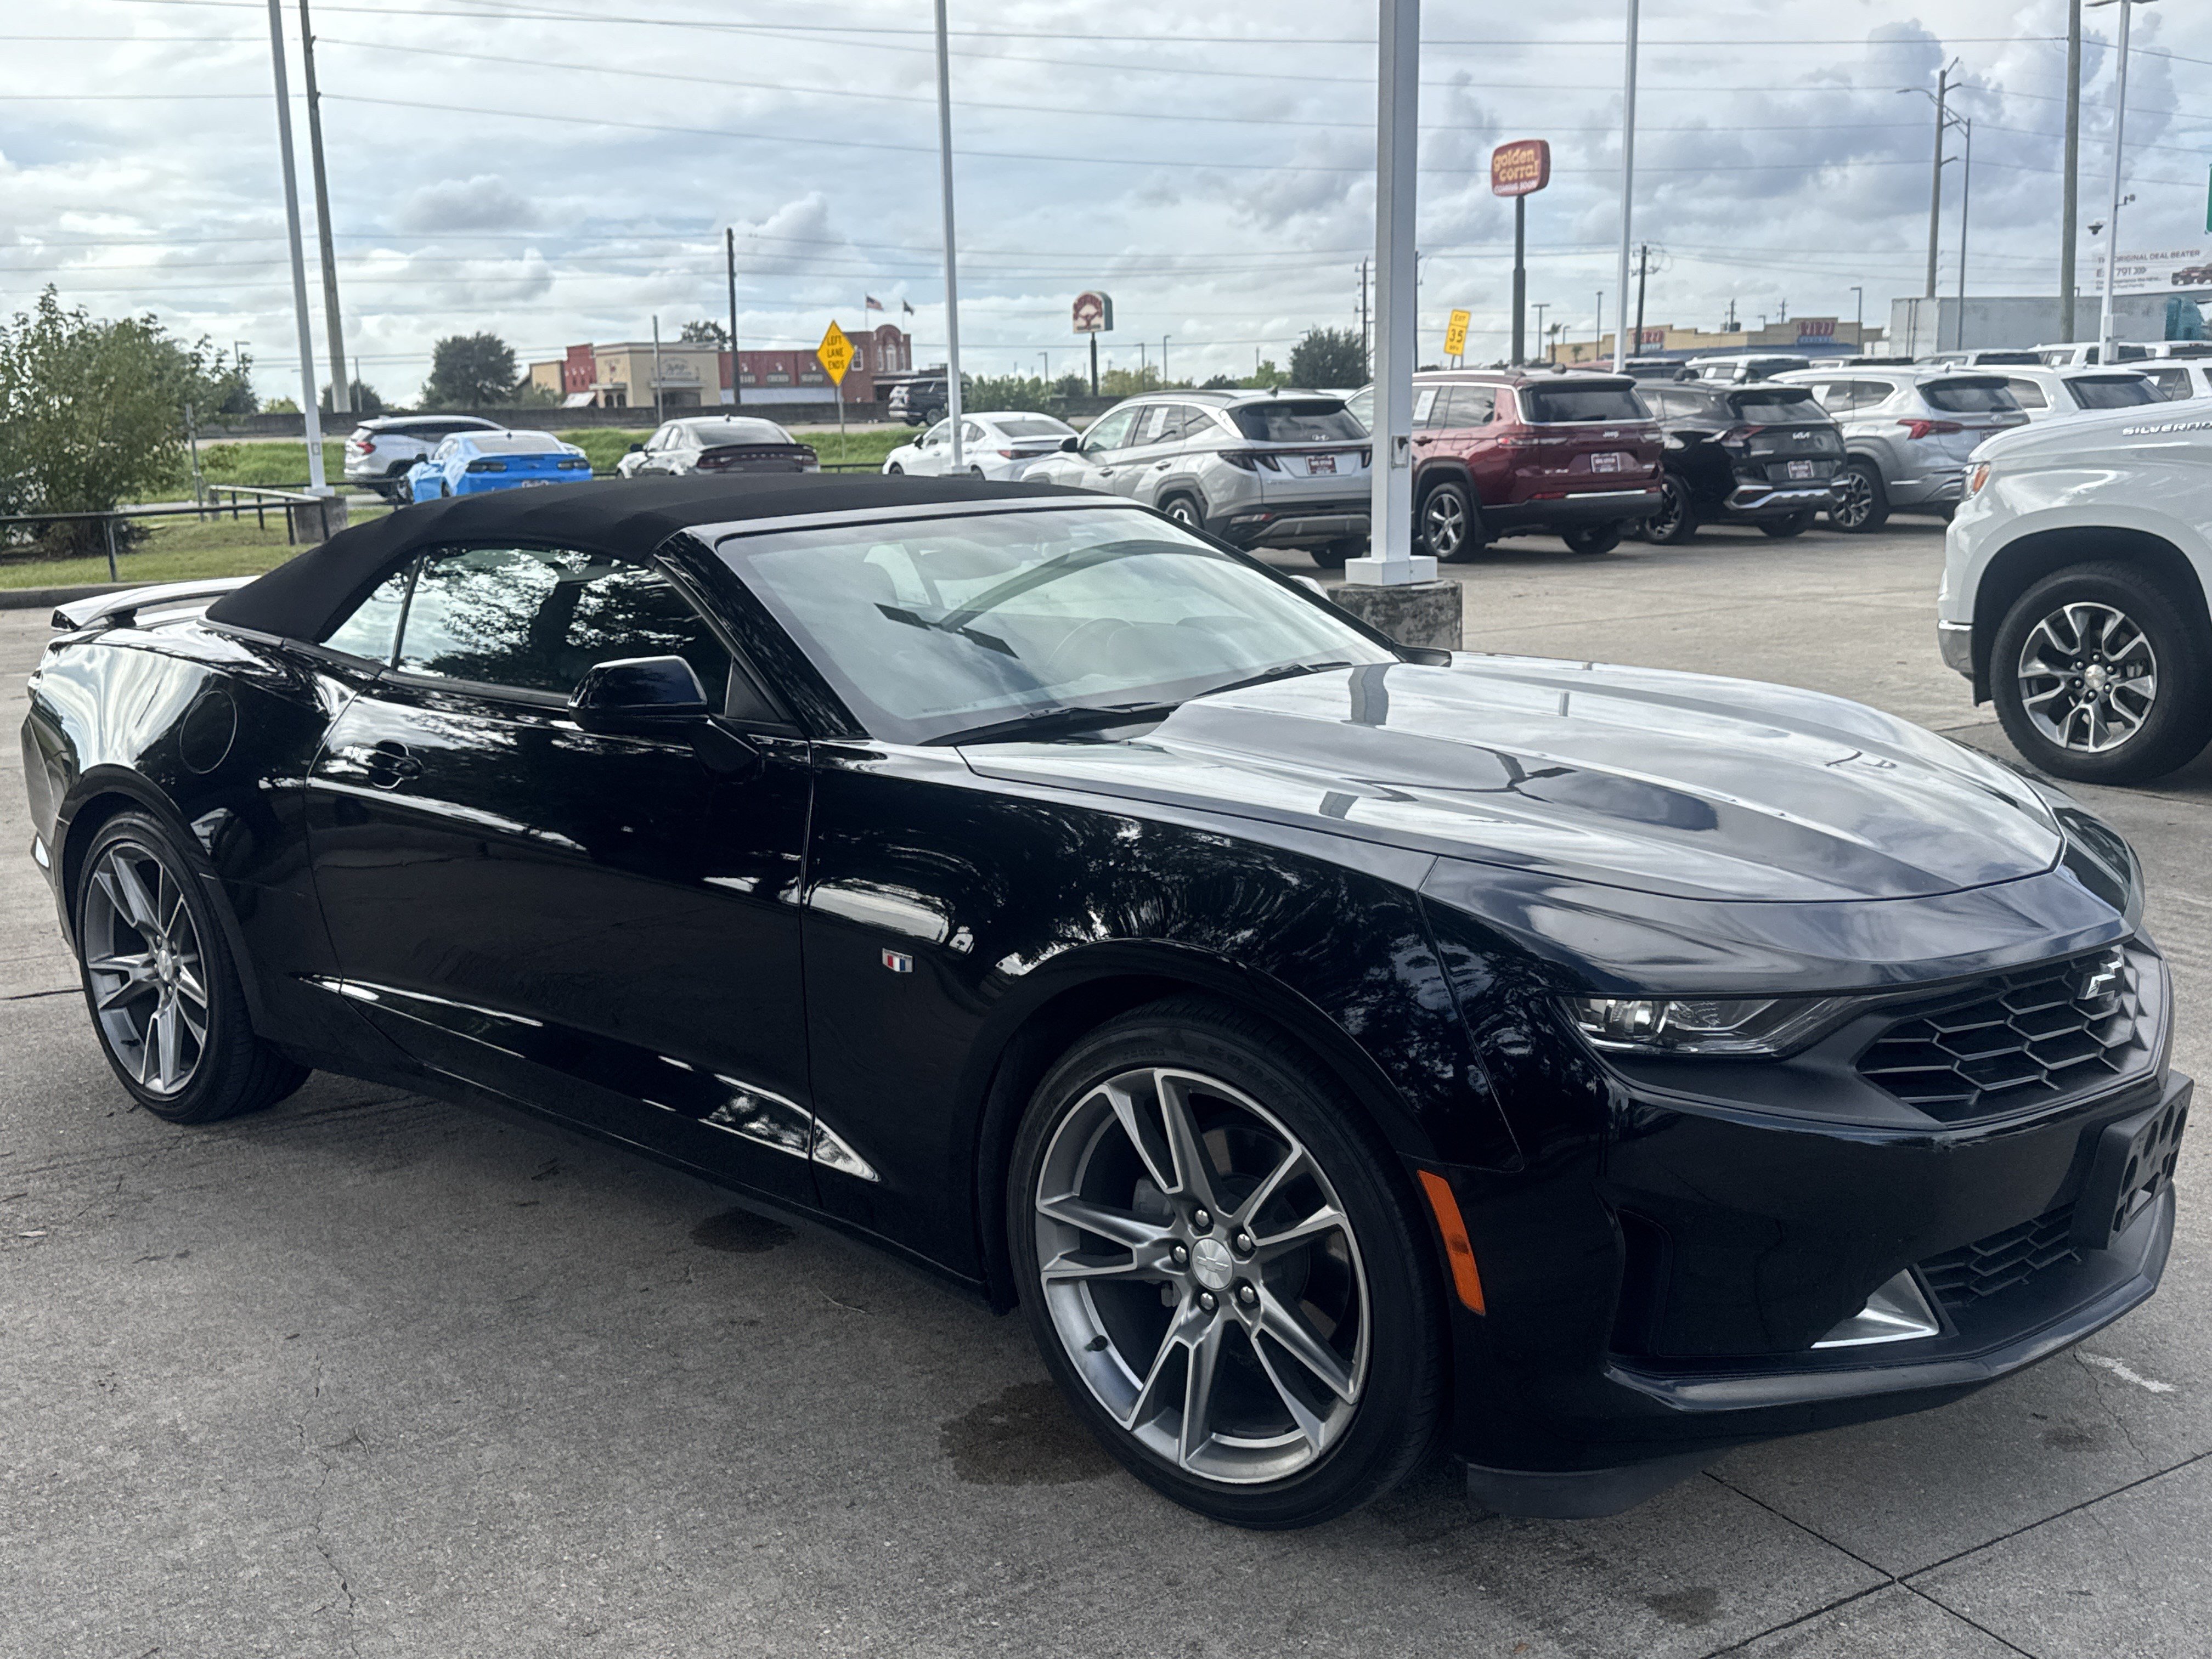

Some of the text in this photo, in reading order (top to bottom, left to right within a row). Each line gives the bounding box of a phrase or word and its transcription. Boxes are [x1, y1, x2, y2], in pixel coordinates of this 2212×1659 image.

[1494, 148, 1535, 172] golden
[1499, 160, 1538, 182] corral
[2149, 251, 2169, 260] DEAL
[2170, 249, 2200, 258] BEATER
[827, 335, 842, 346] LEFT
[1449, 328, 1464, 343] 35
[826, 347, 844, 358] LANE
[827, 360, 845, 370] ENDS
[2122, 421, 2212, 436] SILVERAD
